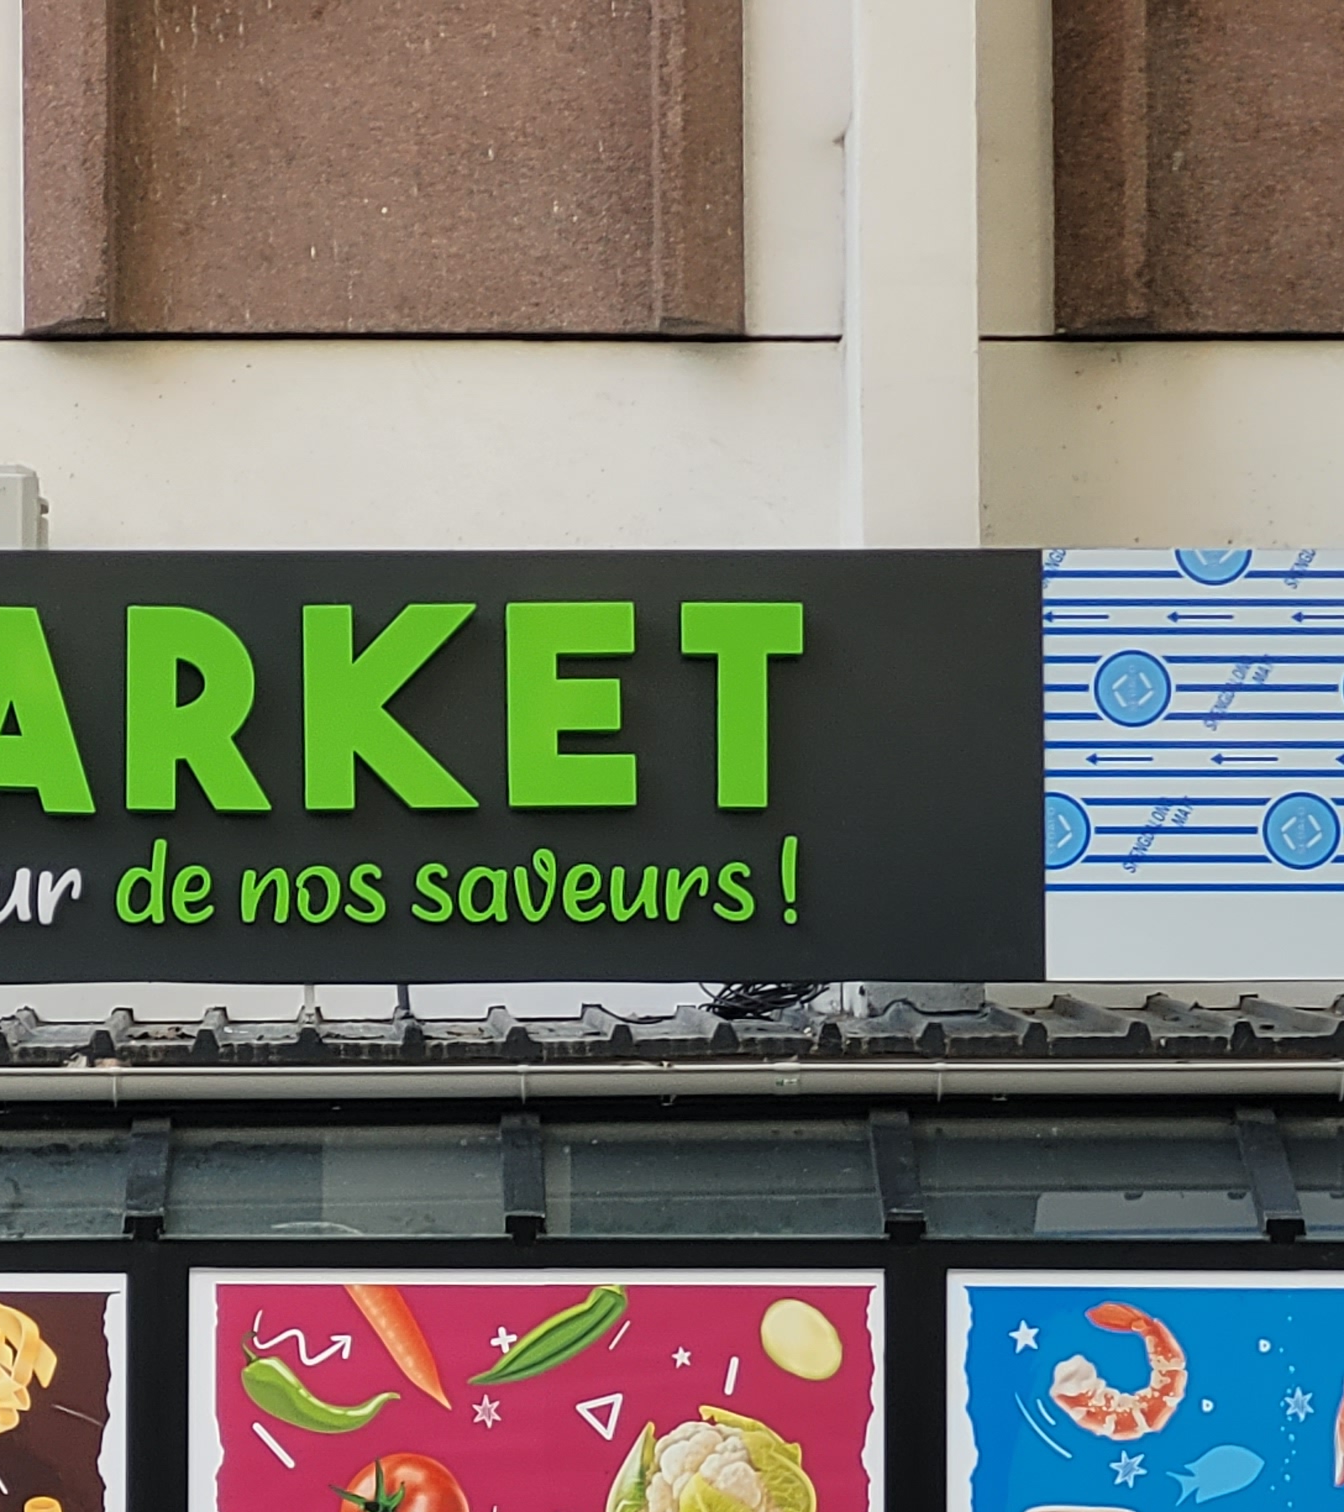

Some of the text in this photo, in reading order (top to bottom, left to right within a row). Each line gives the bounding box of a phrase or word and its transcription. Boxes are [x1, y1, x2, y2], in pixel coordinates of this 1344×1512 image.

[114, 838, 216, 925] de
[241, 858, 387, 926] nos
[411, 848, 757, 926] saveurs
